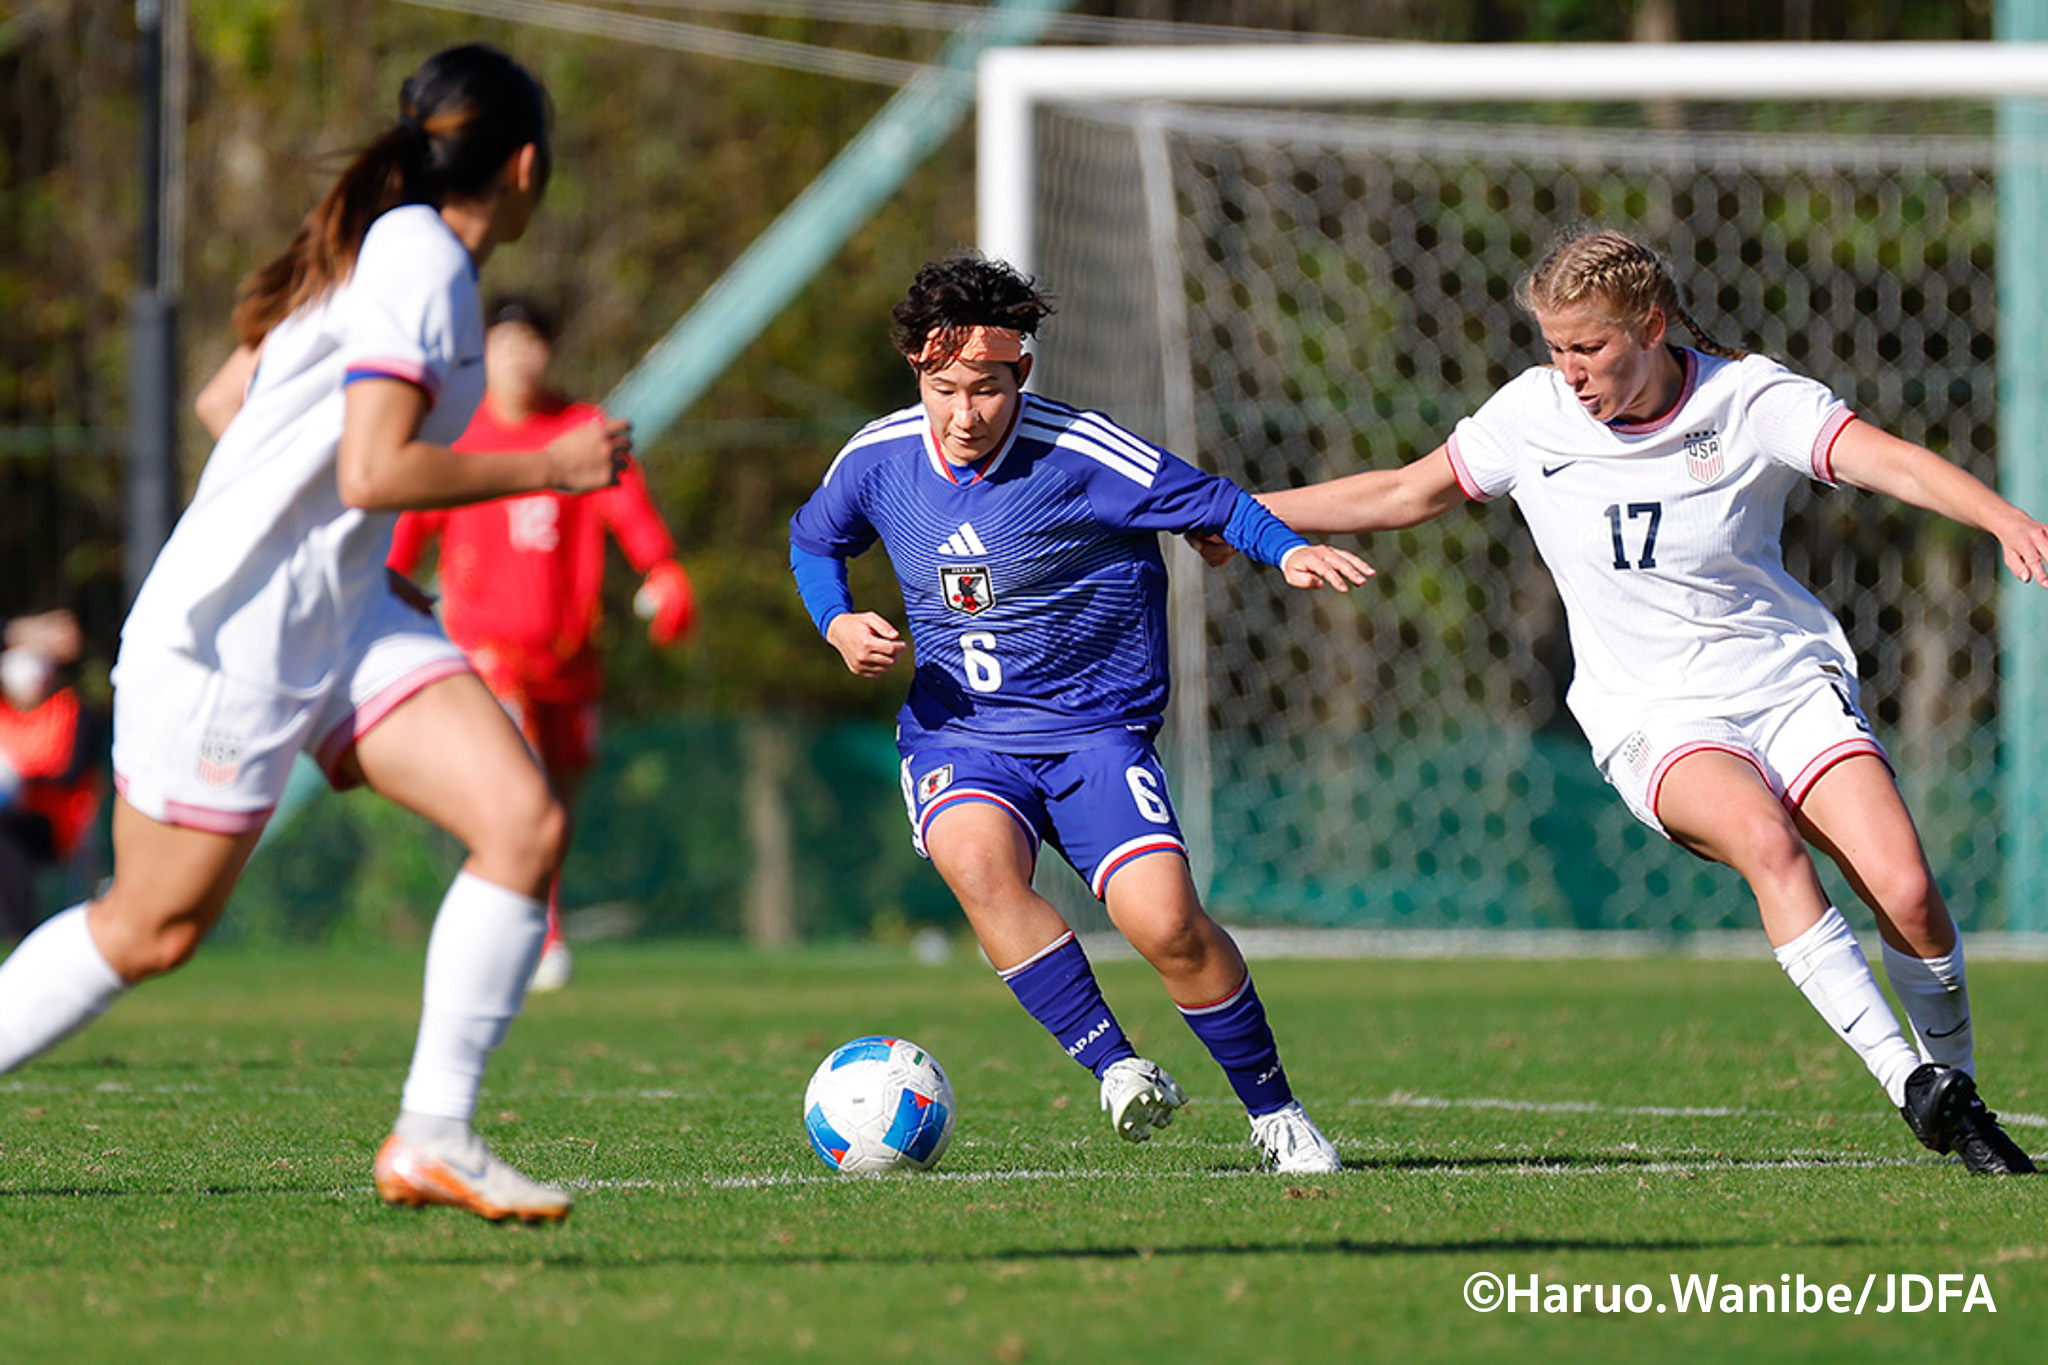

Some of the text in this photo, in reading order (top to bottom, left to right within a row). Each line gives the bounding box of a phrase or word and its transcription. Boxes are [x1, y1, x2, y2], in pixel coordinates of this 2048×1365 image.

[1687, 441, 1719, 460] USA
[1603, 501, 1662, 570] 17
[959, 631, 1003, 693] 6
[1125, 765, 1170, 824] 6
